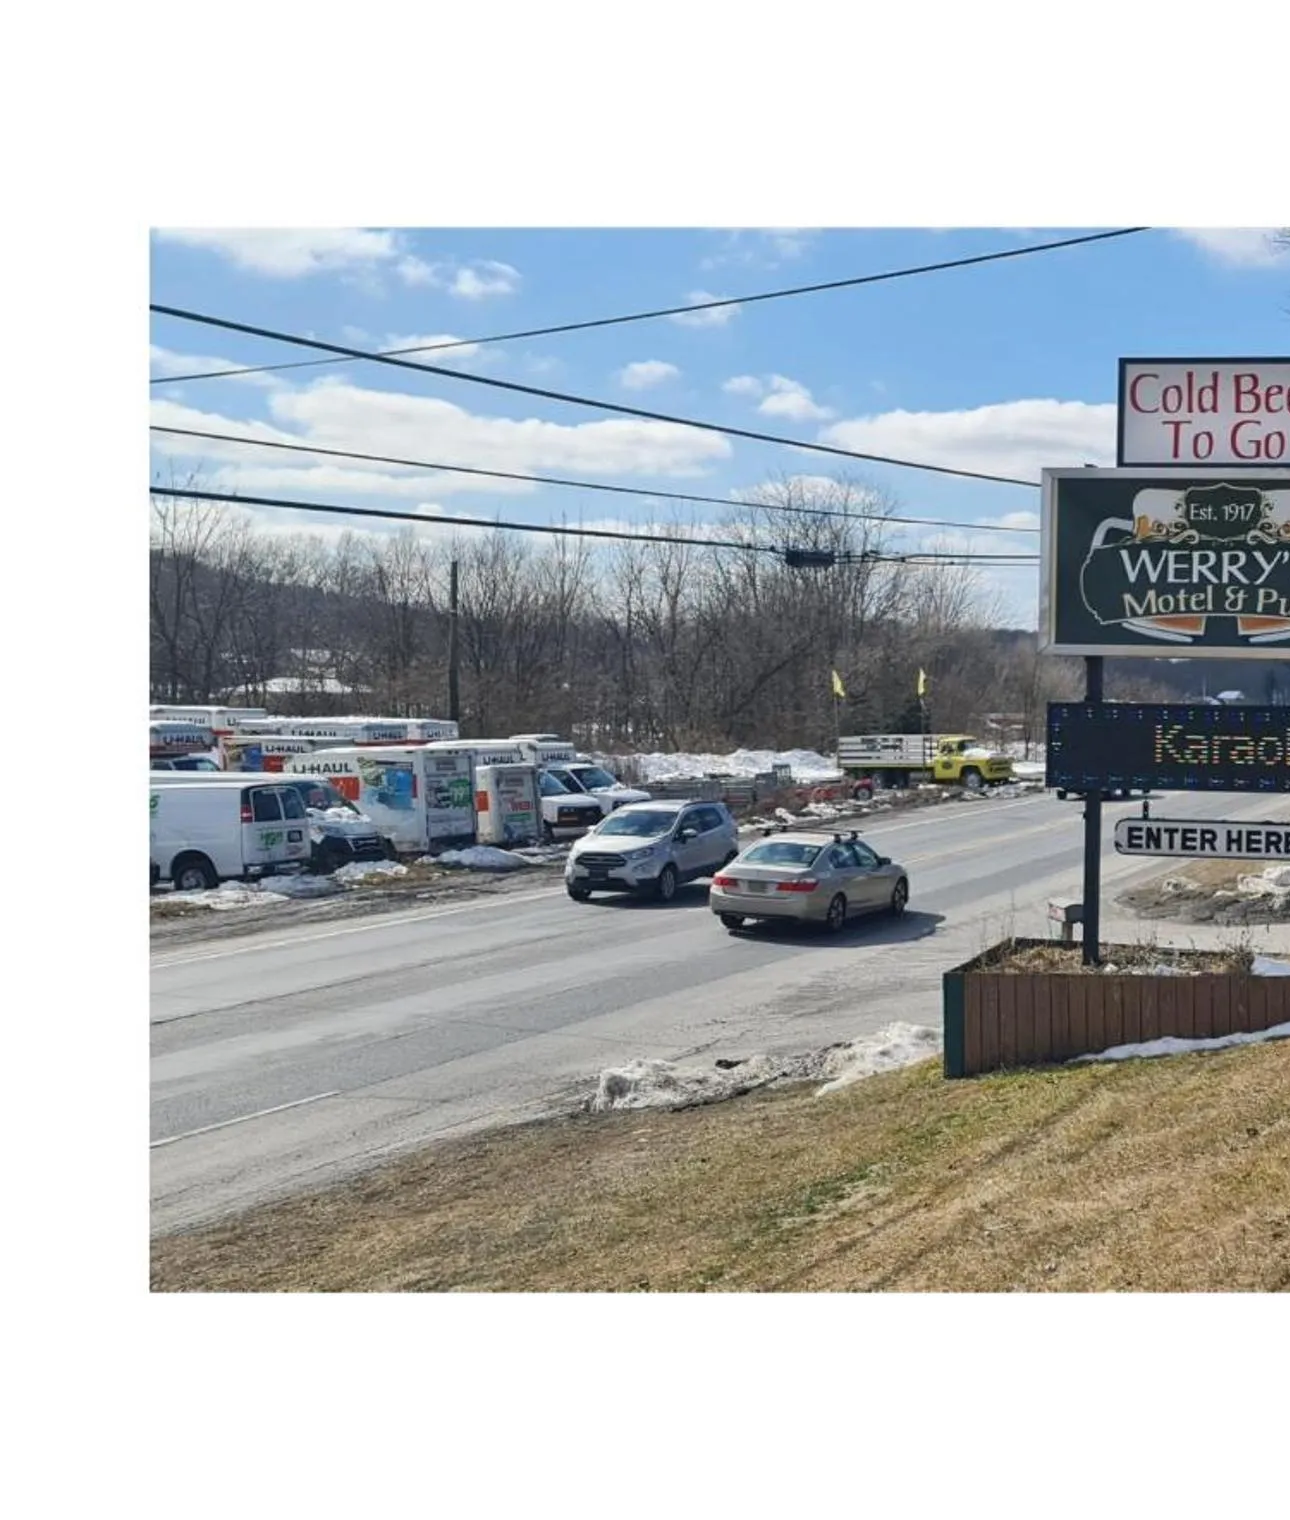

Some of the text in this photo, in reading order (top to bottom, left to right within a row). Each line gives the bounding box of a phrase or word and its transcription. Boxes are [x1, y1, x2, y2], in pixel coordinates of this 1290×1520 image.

[1129, 371, 1219, 414] Cold
[1161, 419, 1286, 460] To Go
[1189, 503, 1256, 522] Est. 1917
[1122, 584, 1213, 617] Motel
[1224, 585, 1249, 611] &
[293, 762, 353, 774] U-HAUL
[1126, 825, 1218, 852] ENTER
